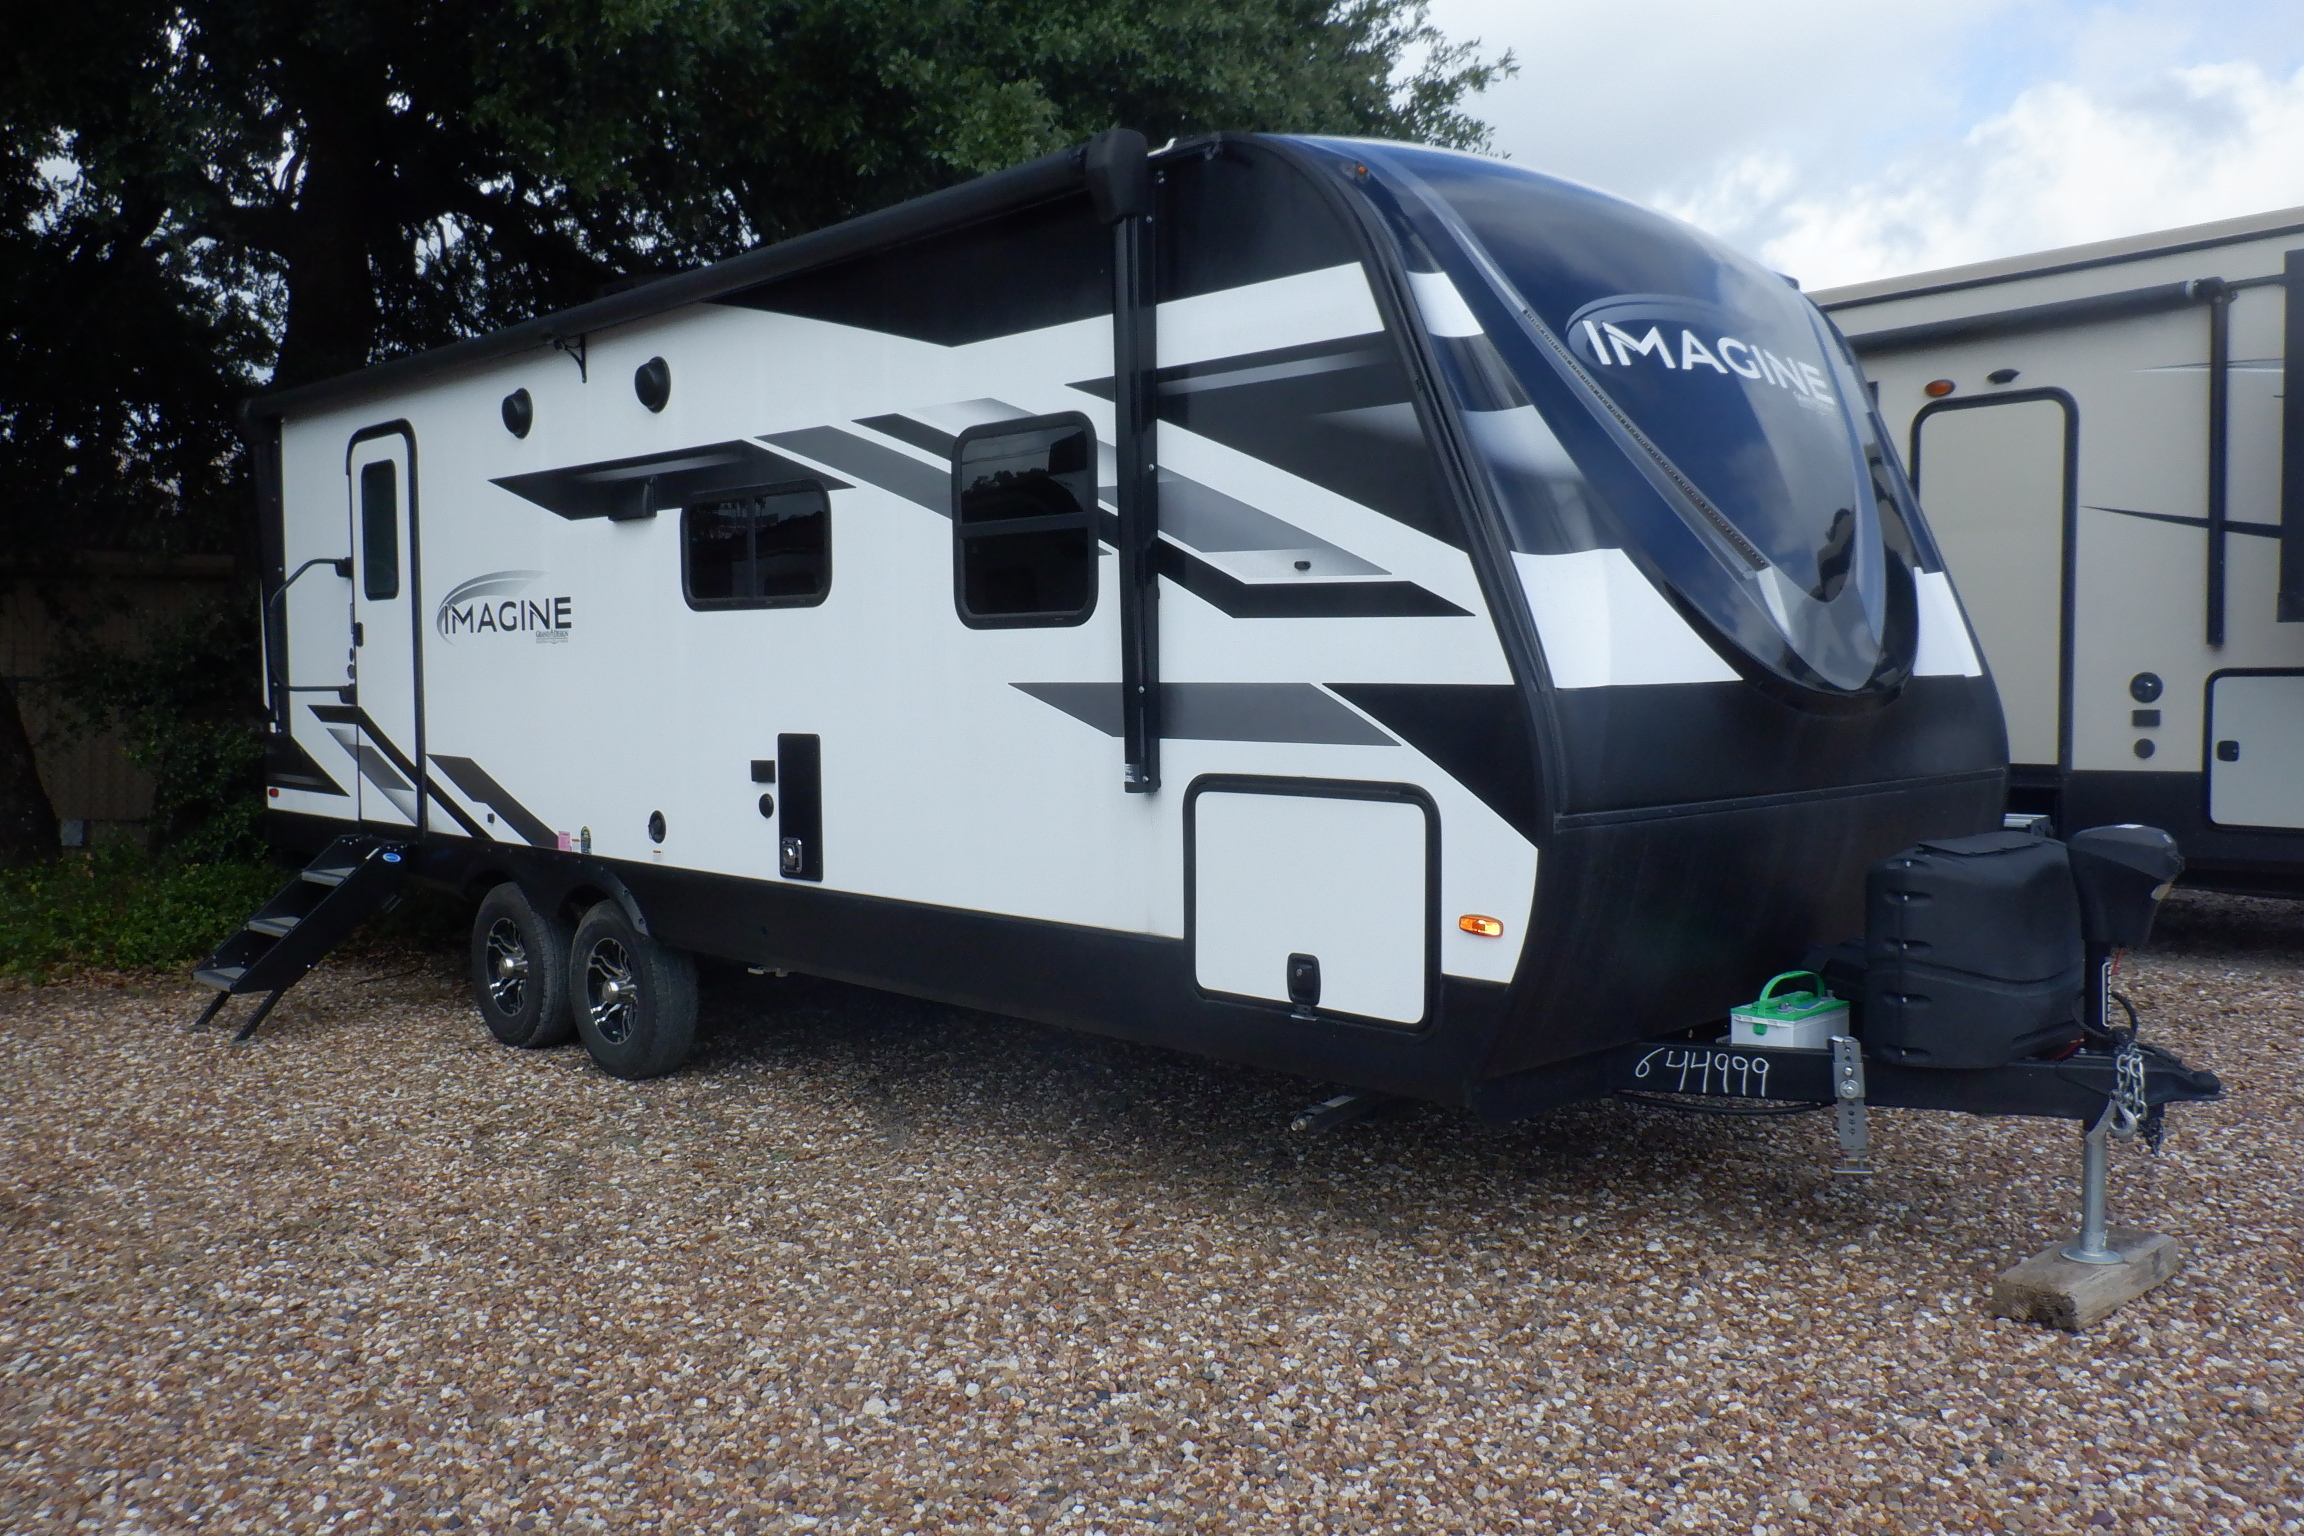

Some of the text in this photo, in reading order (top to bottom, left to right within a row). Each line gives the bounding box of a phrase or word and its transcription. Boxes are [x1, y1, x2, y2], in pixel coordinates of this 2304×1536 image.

[1582, 319, 1835, 405] IMAGINE
[444, 597, 572, 634] IMAGINE
[1635, 1047, 1769, 1097] 644999
